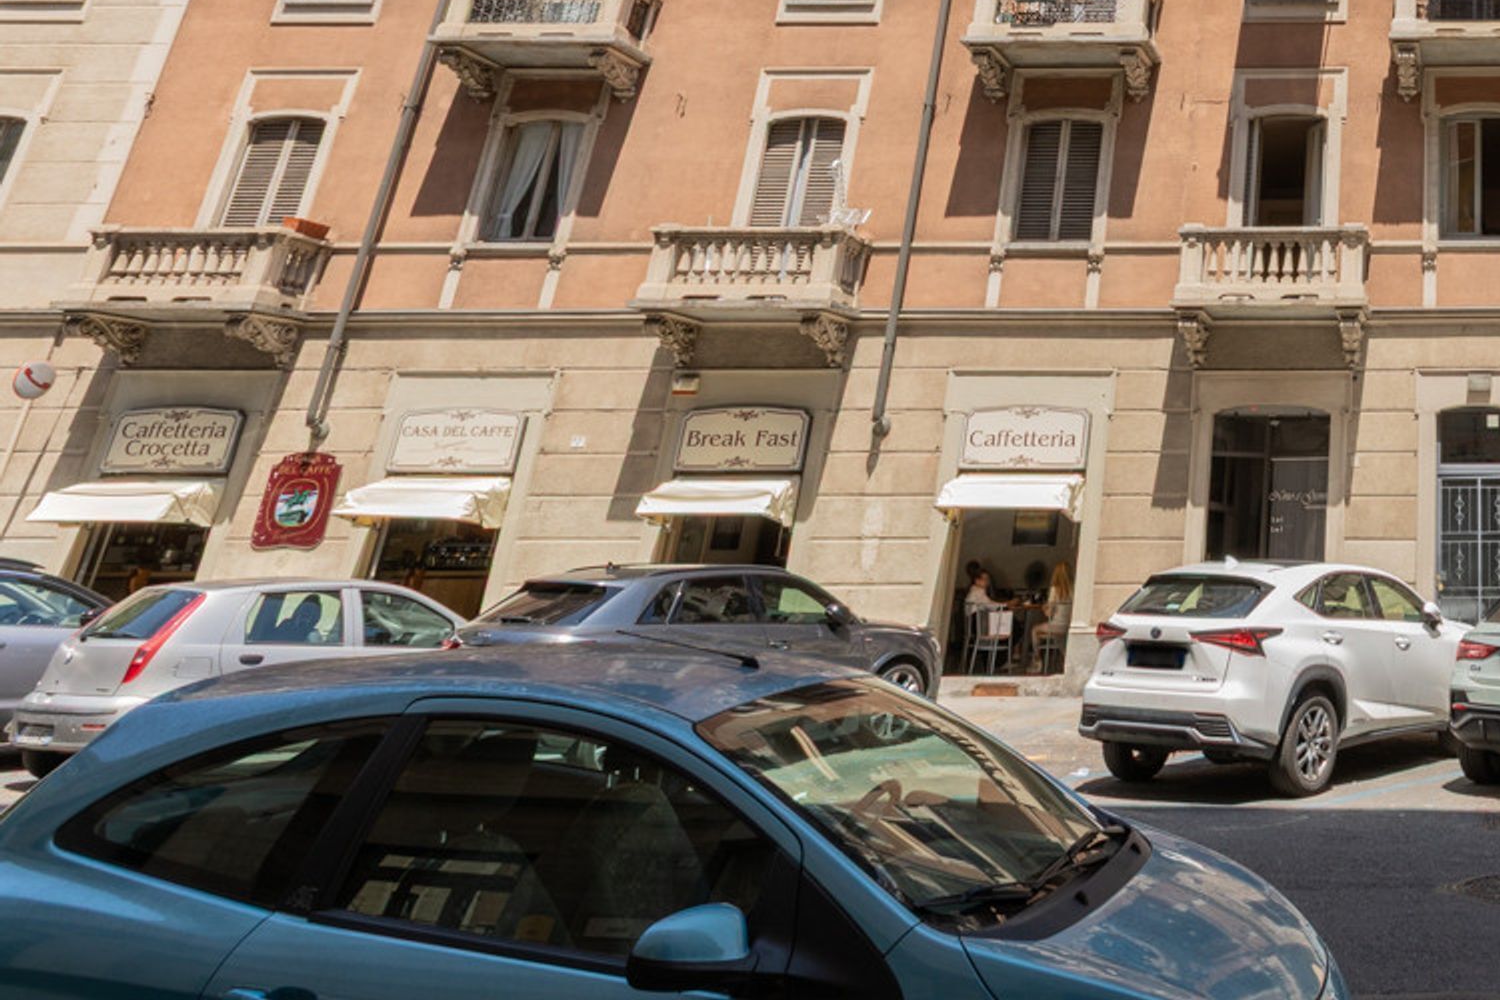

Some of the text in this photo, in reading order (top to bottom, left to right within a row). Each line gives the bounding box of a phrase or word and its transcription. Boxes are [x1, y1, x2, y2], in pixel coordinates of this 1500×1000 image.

[121, 421, 227, 439] Caffetteria
[402, 425, 438, 438] CASA
[443, 425, 466, 438] DEL
[687, 429, 798, 447] Break Fast
[969, 429, 1076, 448] Caffetteria
[124, 440, 210, 456] Crocetta
